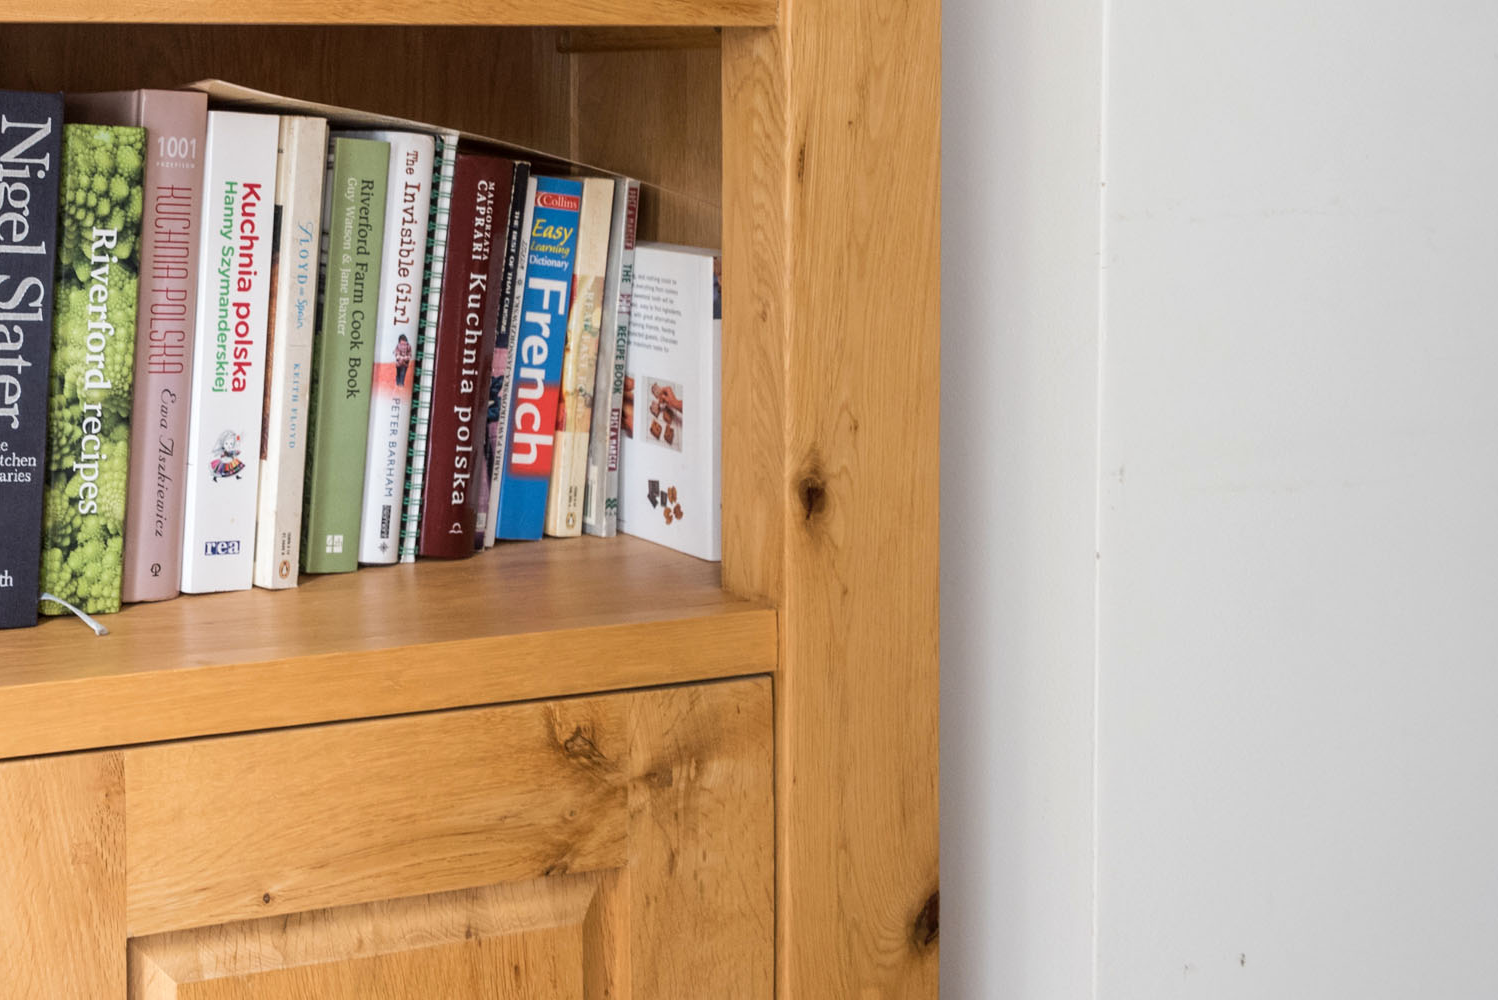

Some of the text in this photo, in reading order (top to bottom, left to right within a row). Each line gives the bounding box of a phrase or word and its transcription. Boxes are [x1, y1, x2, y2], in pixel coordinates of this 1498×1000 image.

[156, 136, 197, 160] 1001
[346, 177, 358, 200] Guy
[153, 184, 193, 280] KUCHNIA
[342, 202, 357, 251] Watson
[393, 151, 421, 326] The Invisible Girl
[532, 218, 574, 244] Easy
[231, 183, 262, 393] Kuchnia polska
[339, 264, 349, 295] Jane
[529, 254, 569, 272] Dictionary
[147, 287, 187, 375] POLSKA
[337, 300, 349, 337] Baxter
[73, 226, 118, 515] Riverford recipes
[452, 271, 487, 505] Kuchnia polska
[511, 276, 568, 465] French
[388, 397, 401, 436] PETER
[382, 440, 397, 497] BARHAM
